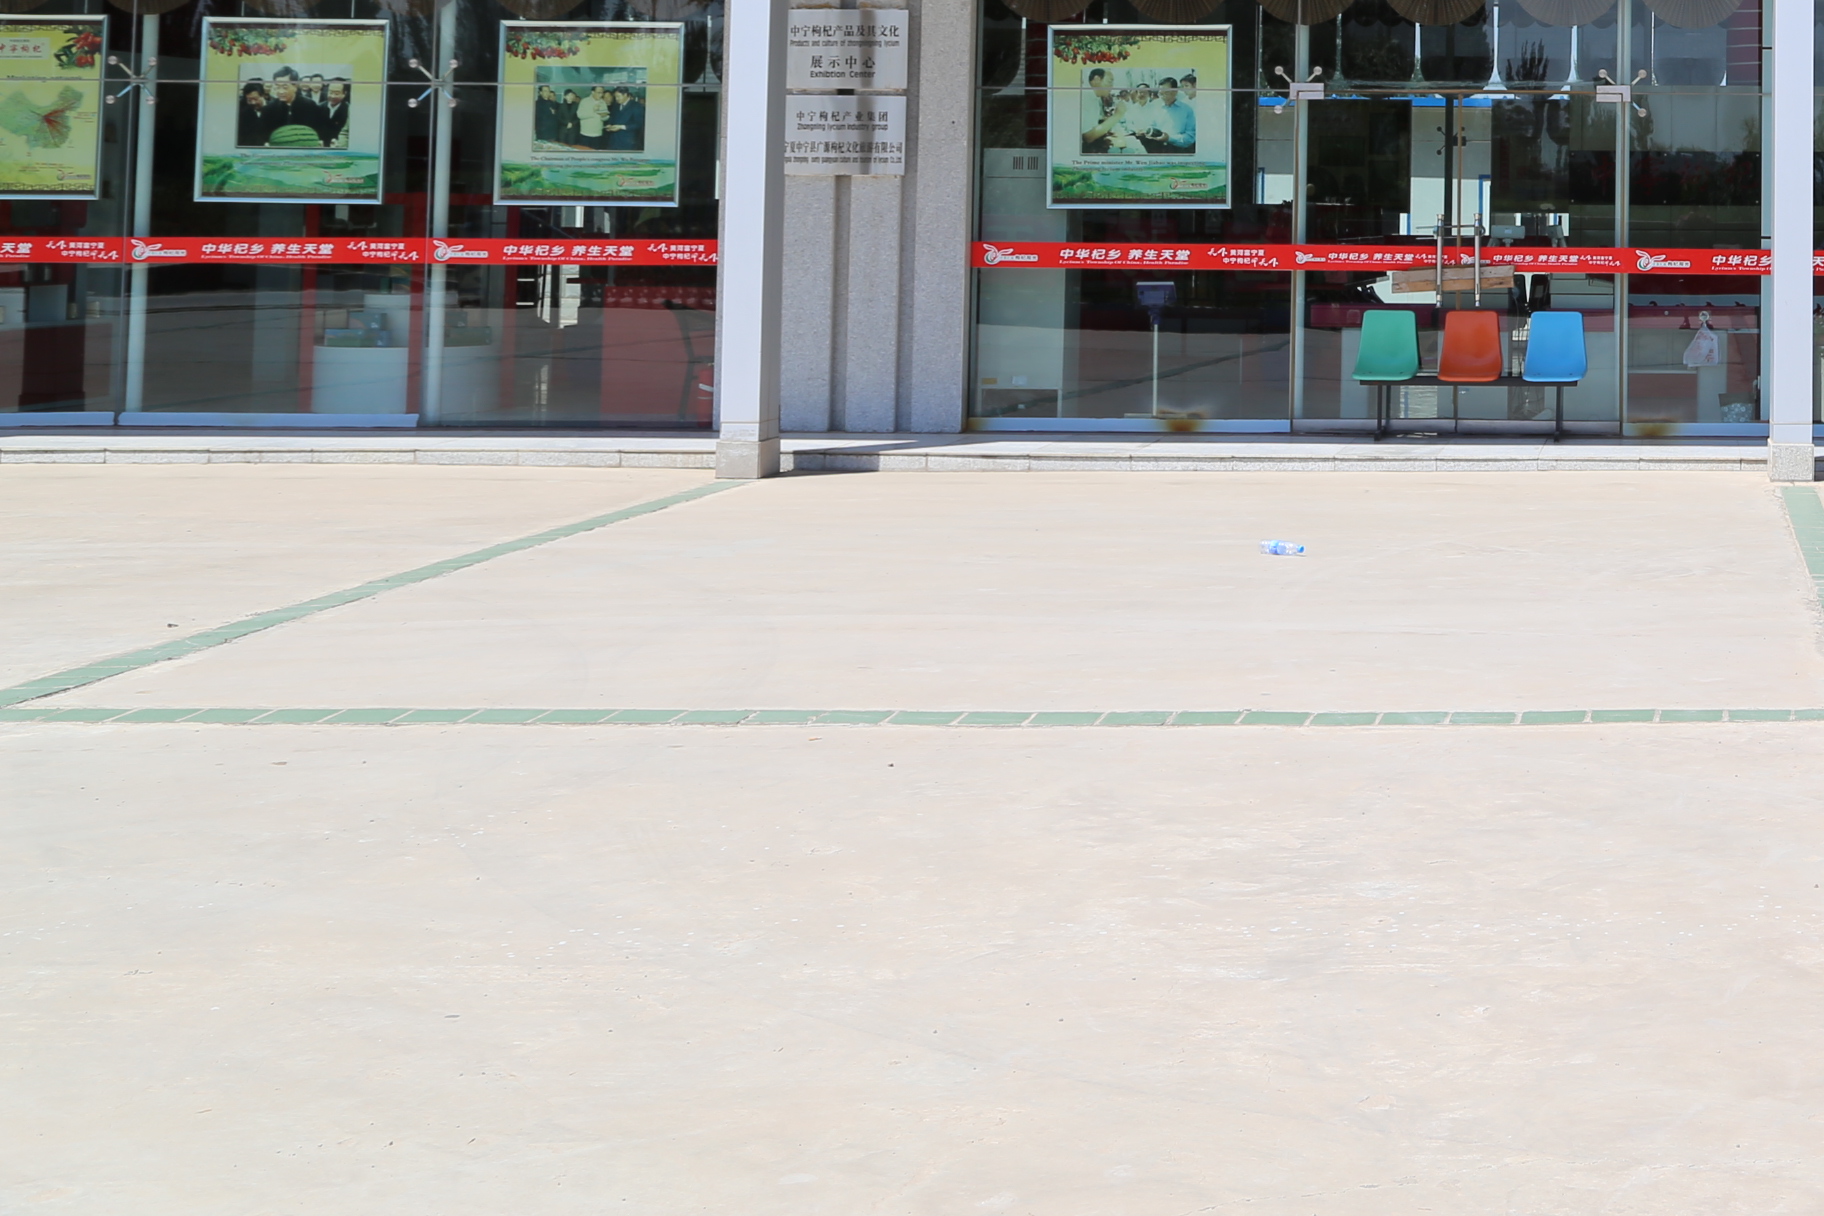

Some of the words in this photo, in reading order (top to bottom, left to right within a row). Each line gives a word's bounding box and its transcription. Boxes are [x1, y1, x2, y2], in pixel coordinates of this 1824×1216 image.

[790, 25, 899, 37] 中宁枸杞产品及其文化
[810, 55, 876, 69] 展示中心
[849, 70, 876, 78] Center
[796, 111, 888, 122] 中宁枸杞产业集团
[201, 242, 265, 254] 中华杞乡
[270, 243, 334, 255] 养生天堂
[503, 244, 566, 256] 中华杞乡
[572, 245, 635, 256] 养生天堂
[1059, 248, 1122, 260] 中华杞乡
[1128, 248, 1191, 260] 养生天堂
[1712, 254, 1772, 266] 中华杞乡
